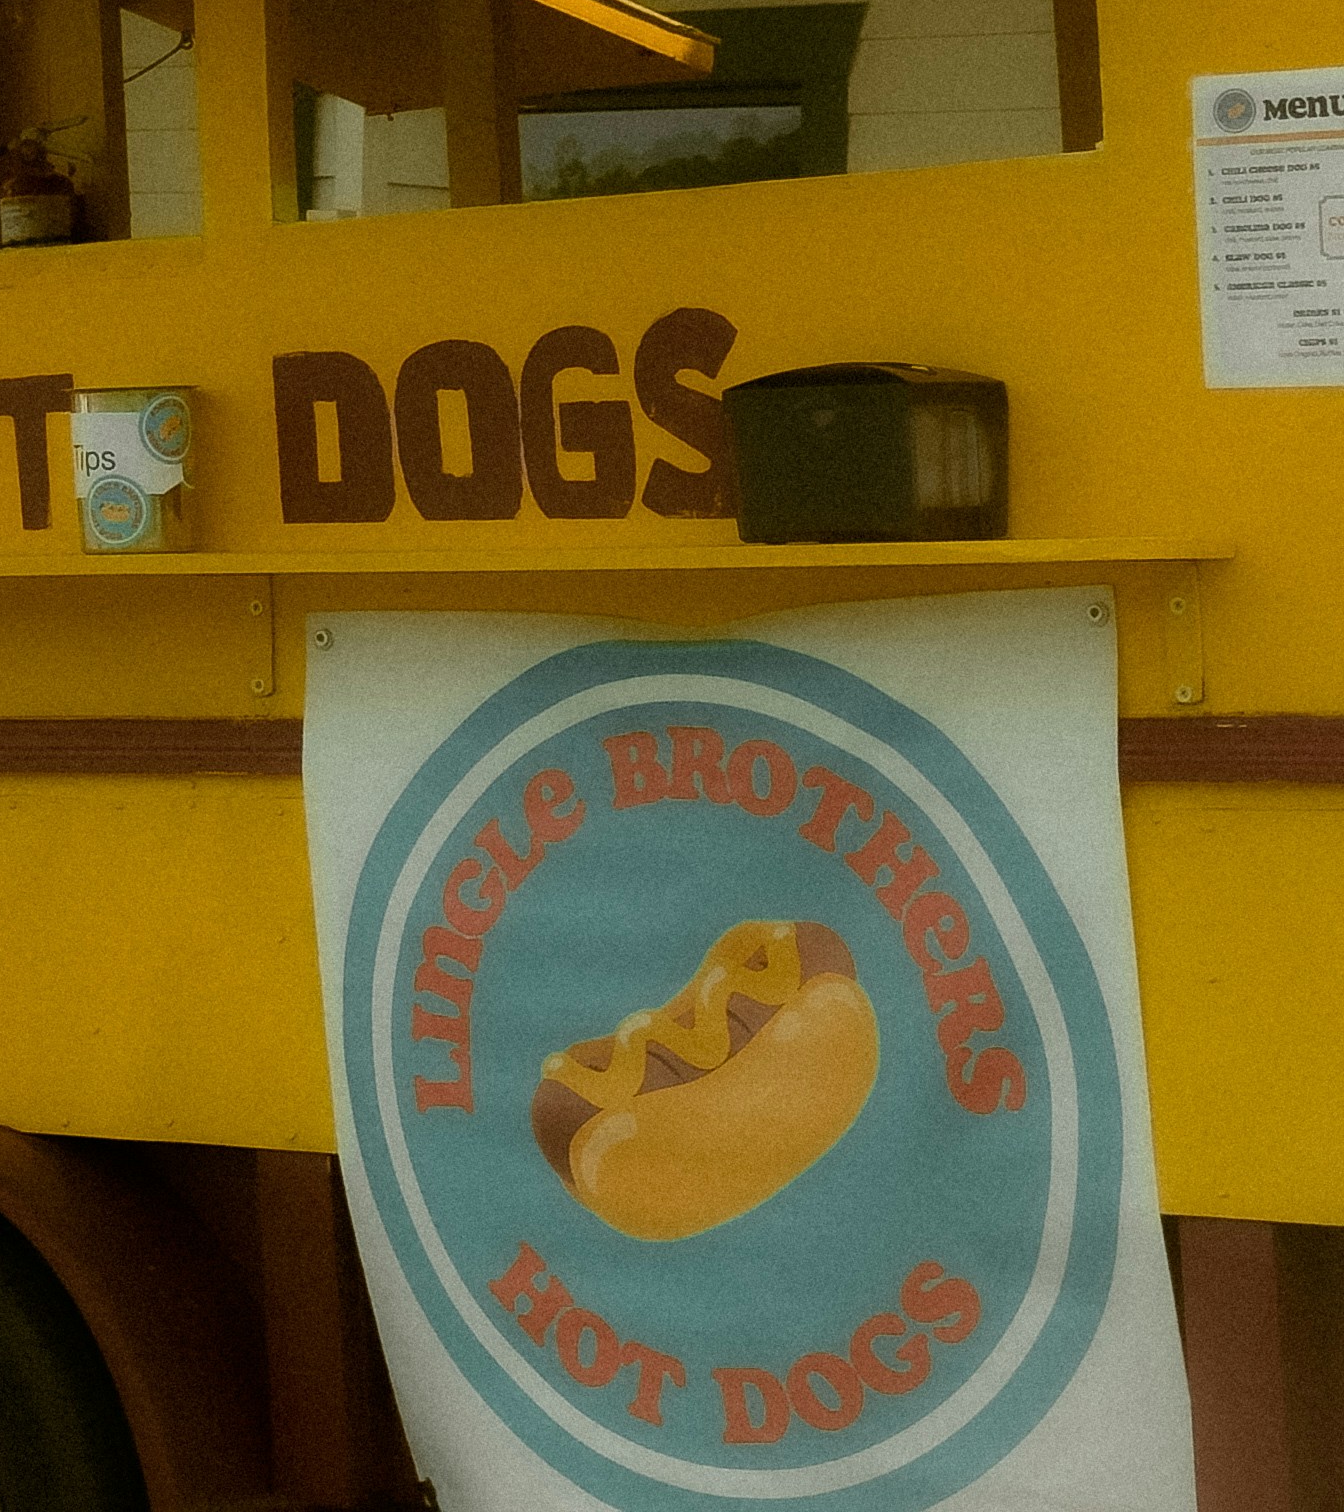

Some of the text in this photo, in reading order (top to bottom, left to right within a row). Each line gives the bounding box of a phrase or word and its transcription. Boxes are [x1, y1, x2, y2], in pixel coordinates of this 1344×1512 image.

[274, 306, 740, 523] DOGS
[604, 726, 1026, 1117] BROTHERS
[489, 1242, 982, 1446] HOT DOGS
